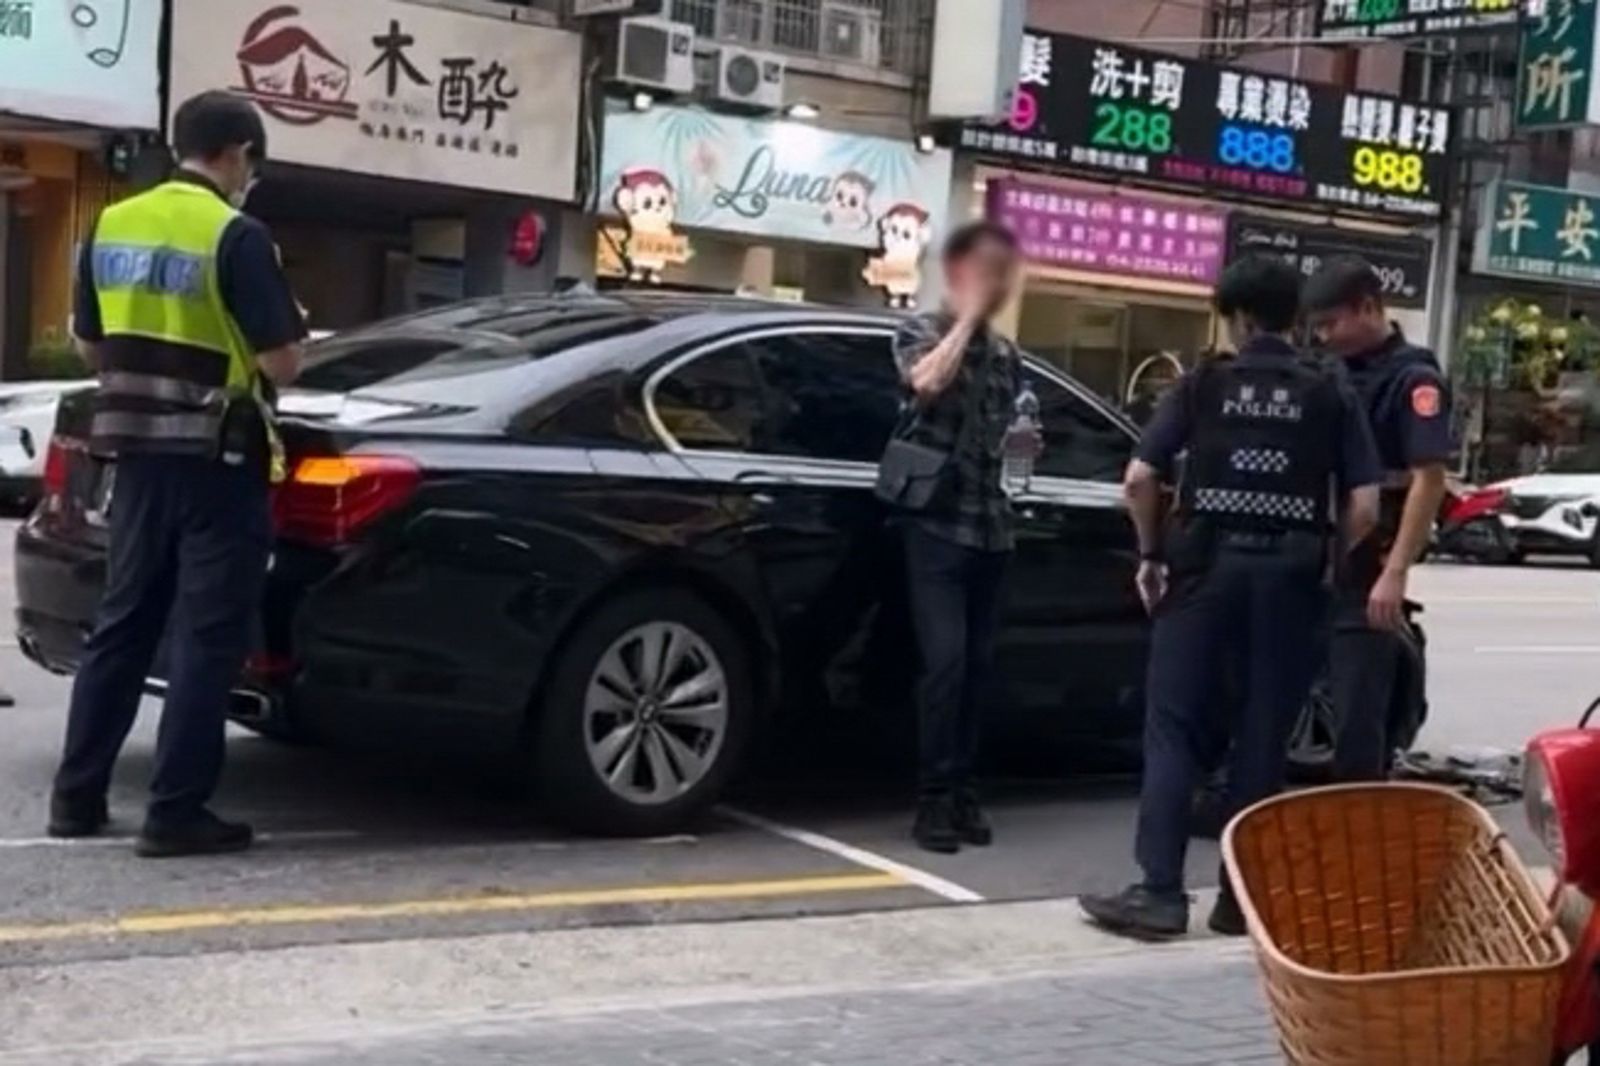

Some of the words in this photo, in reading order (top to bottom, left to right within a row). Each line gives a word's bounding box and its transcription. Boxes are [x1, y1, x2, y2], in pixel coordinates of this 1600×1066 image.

[1092, 103, 1172, 153] 288
[1219, 126, 1294, 173] 888
[714, 144, 833, 219] Luna
[1353, 147, 1423, 193] 988
[1496, 192, 1600, 261] 平安
[1222, 400, 1302, 420] POLICE
